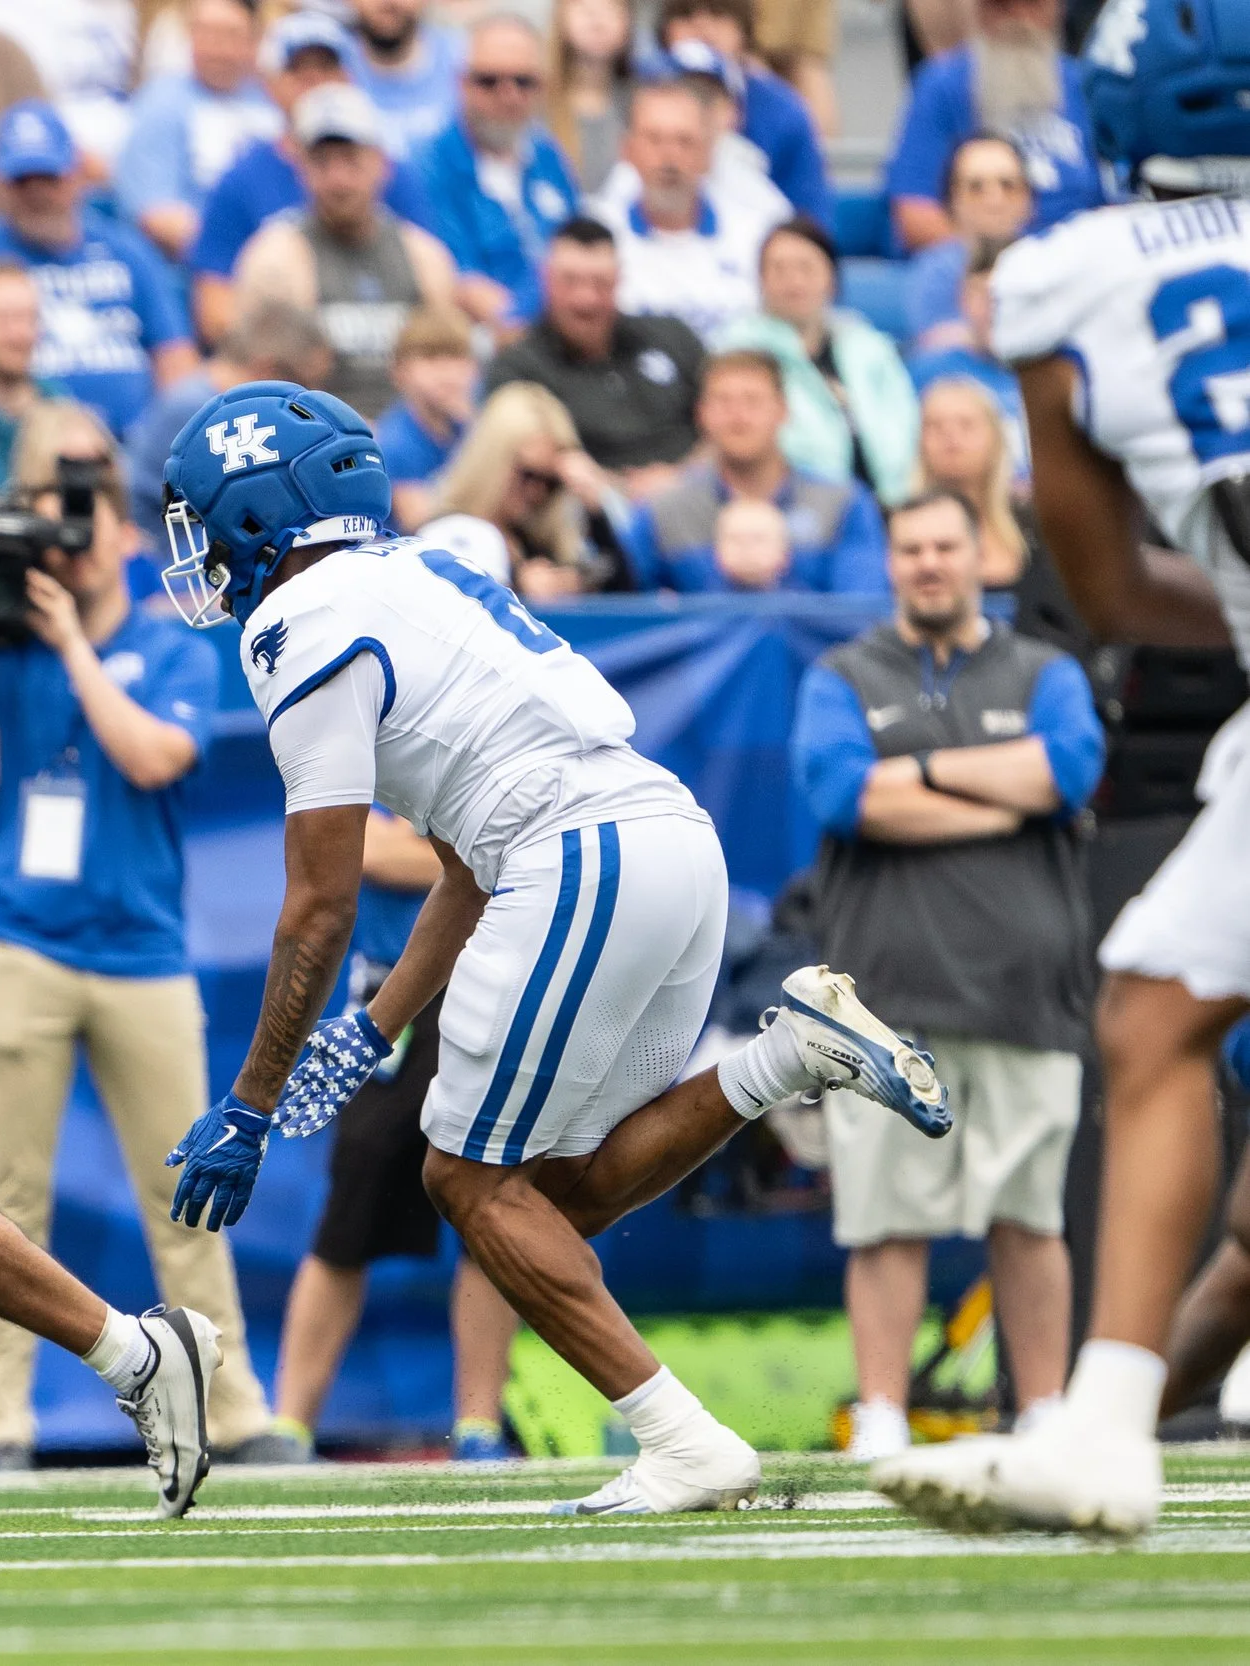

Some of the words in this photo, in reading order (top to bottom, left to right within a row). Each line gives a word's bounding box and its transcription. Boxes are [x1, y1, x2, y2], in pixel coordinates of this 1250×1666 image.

[205, 413, 280, 474] UK
[806, 1040, 831, 1052] ZOOM
[832, 1049, 864, 1065] AIR
